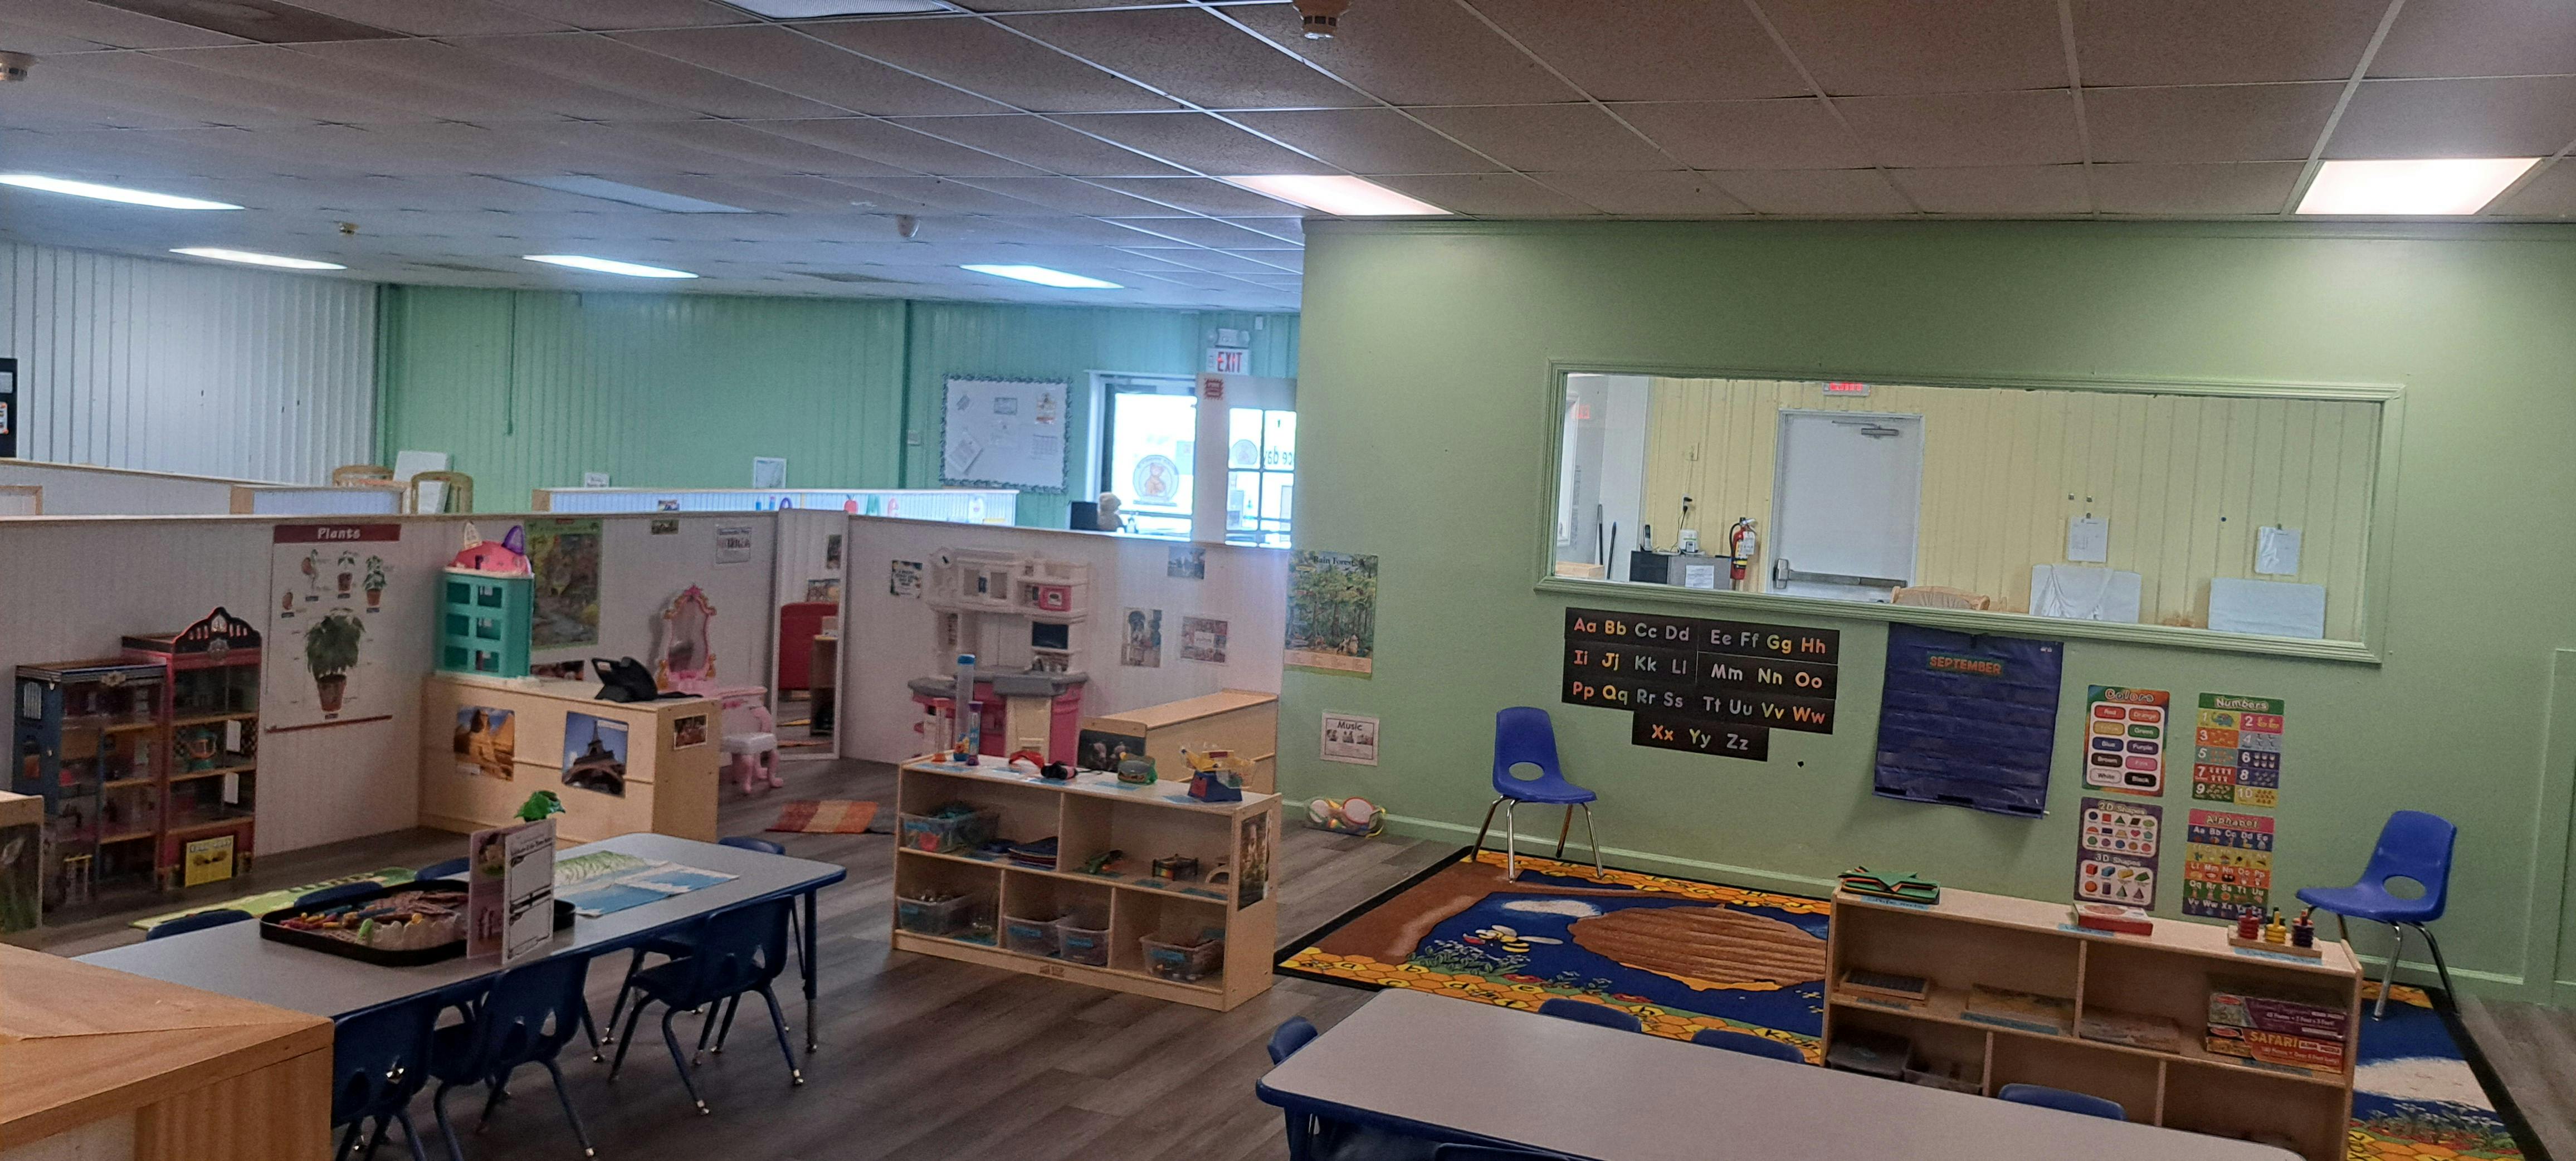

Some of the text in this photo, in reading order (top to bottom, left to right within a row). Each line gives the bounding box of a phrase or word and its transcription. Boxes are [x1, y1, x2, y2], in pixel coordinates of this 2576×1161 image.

[1217, 352, 1242, 373] EXIT
[317, 527, 361, 540] Plants
[1314, 555, 1357, 567] Rain Forest
[1573, 617, 1690, 642] Aa Bb Cc Dd
[1711, 630, 1827, 655] Ee Ff Gg Hh
[1573, 650, 1687, 675] Ii Jj Kk Ll
[1929, 656, 2002, 674] SEPTEMBER
[1711, 663, 1823, 689] Mm Nn Oo
[1573, 681, 1684, 709] Pp Qq Rr Ss
[2105, 688, 2155, 703] Colors
[1702, 695, 1826, 725] Tt Uu Vv Ww
[2216, 697, 2268, 710] Numbers
[2202, 713, 2207, 721] 1
[2245, 715, 2253, 726] 2
[1337, 720, 1363, 731] Music
[1651, 724, 1749, 751] Xx Yy Zz
[2199, 729, 2208, 740] 3
[2242, 734, 2252, 744] 4
[2198, 748, 2207, 758] 5
[2242, 752, 2251, 763] 6
[2197, 765, 2206, 777] 7
[2240, 769, 2249, 780] 8
[2196, 783, 2206, 794] 9
[2237, 788, 2253, 798] 10
[2206, 816, 2258, 828] Alphabet
[2189, 880, 2202, 889] Qq
[2252, 888, 2264, 896] Uu
[2250, 1031, 2298, 1047] SAFARI
